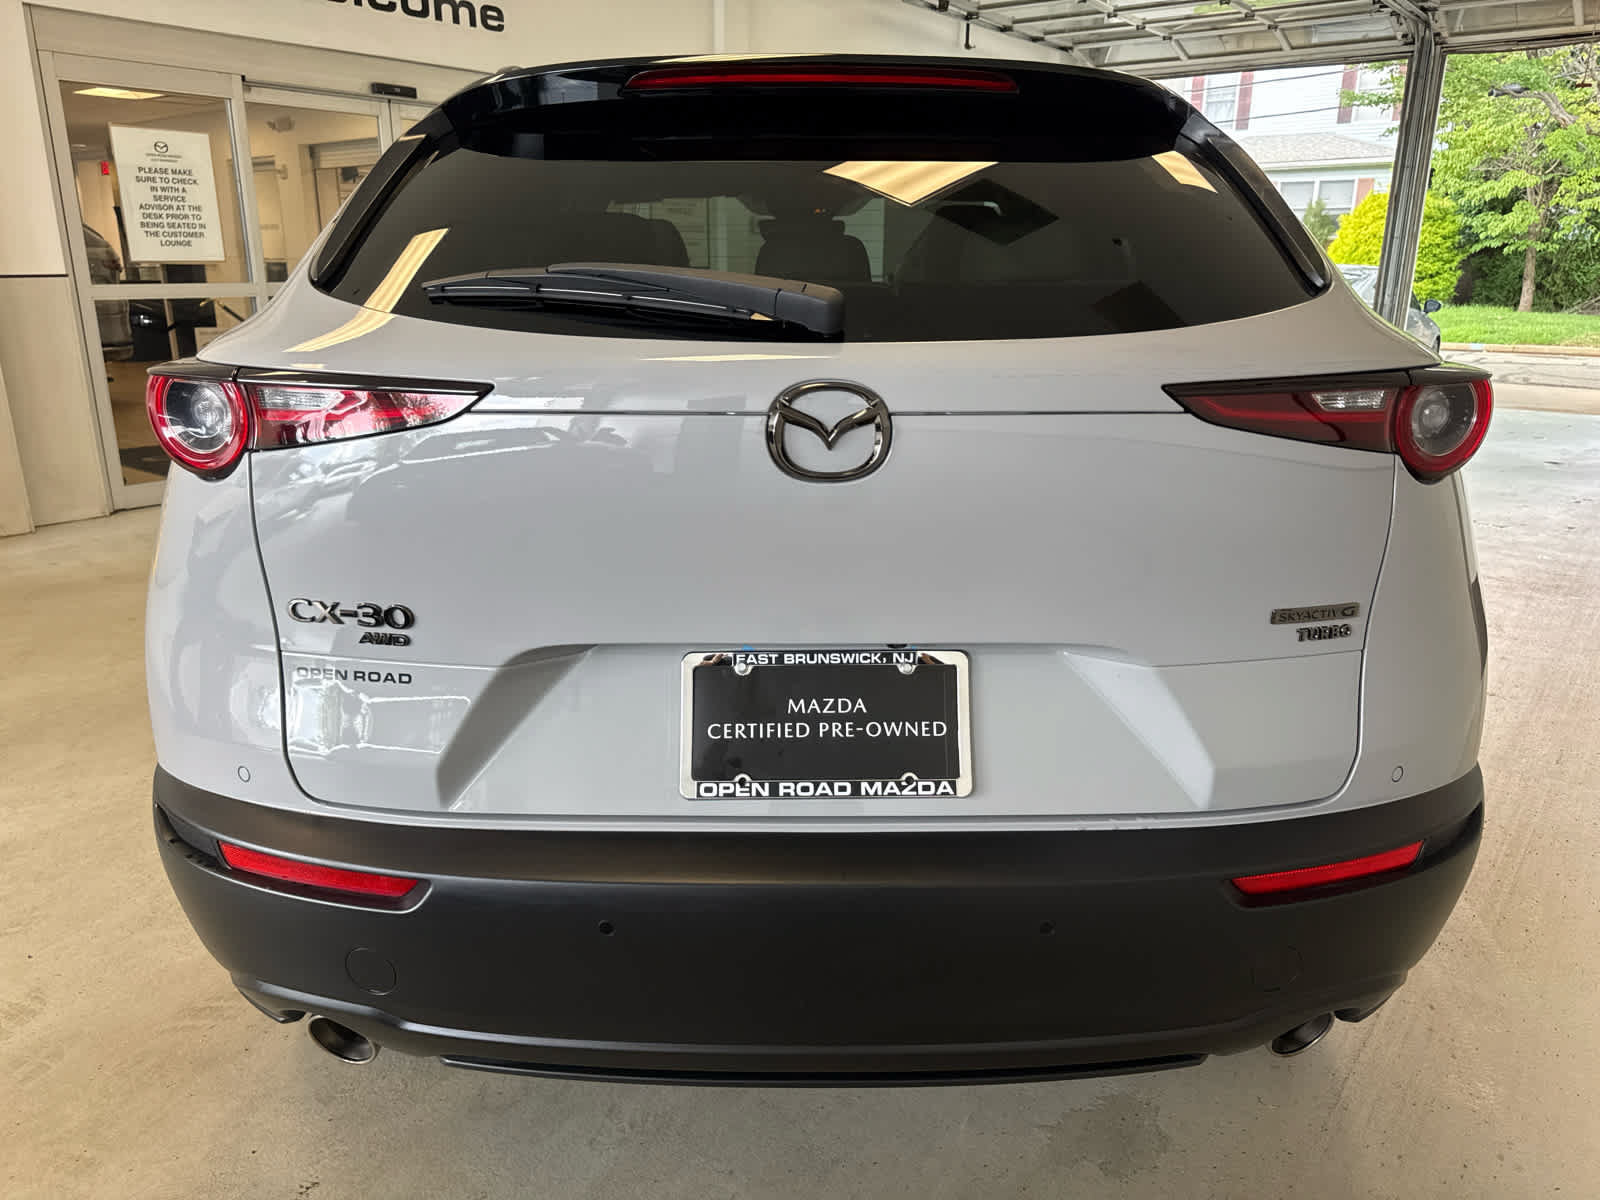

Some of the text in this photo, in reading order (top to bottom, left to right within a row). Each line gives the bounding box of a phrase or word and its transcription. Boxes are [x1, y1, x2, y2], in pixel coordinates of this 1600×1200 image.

[138, 167, 169, 175] PLEASE
[172, 177, 199, 185] CHECK
[139, 203, 174, 211] ADVISOR
[153, 195, 187, 203] SERVICE
[140, 221, 165, 229] BEING
[288, 598, 416, 629] CX-30
[358, 631, 411, 647] AWD
[1296, 624, 1352, 642] TURBO
[735, 653, 915, 665] EAST BRUNSWICK, NJ
[296, 666, 413, 684] OPEN ROAD
[787, 698, 867, 714] MAZDA
[707, 721, 948, 739] CERTIFIED PRE-OWNED
[699, 780, 955, 797] OPEN ROAD MAZDA
